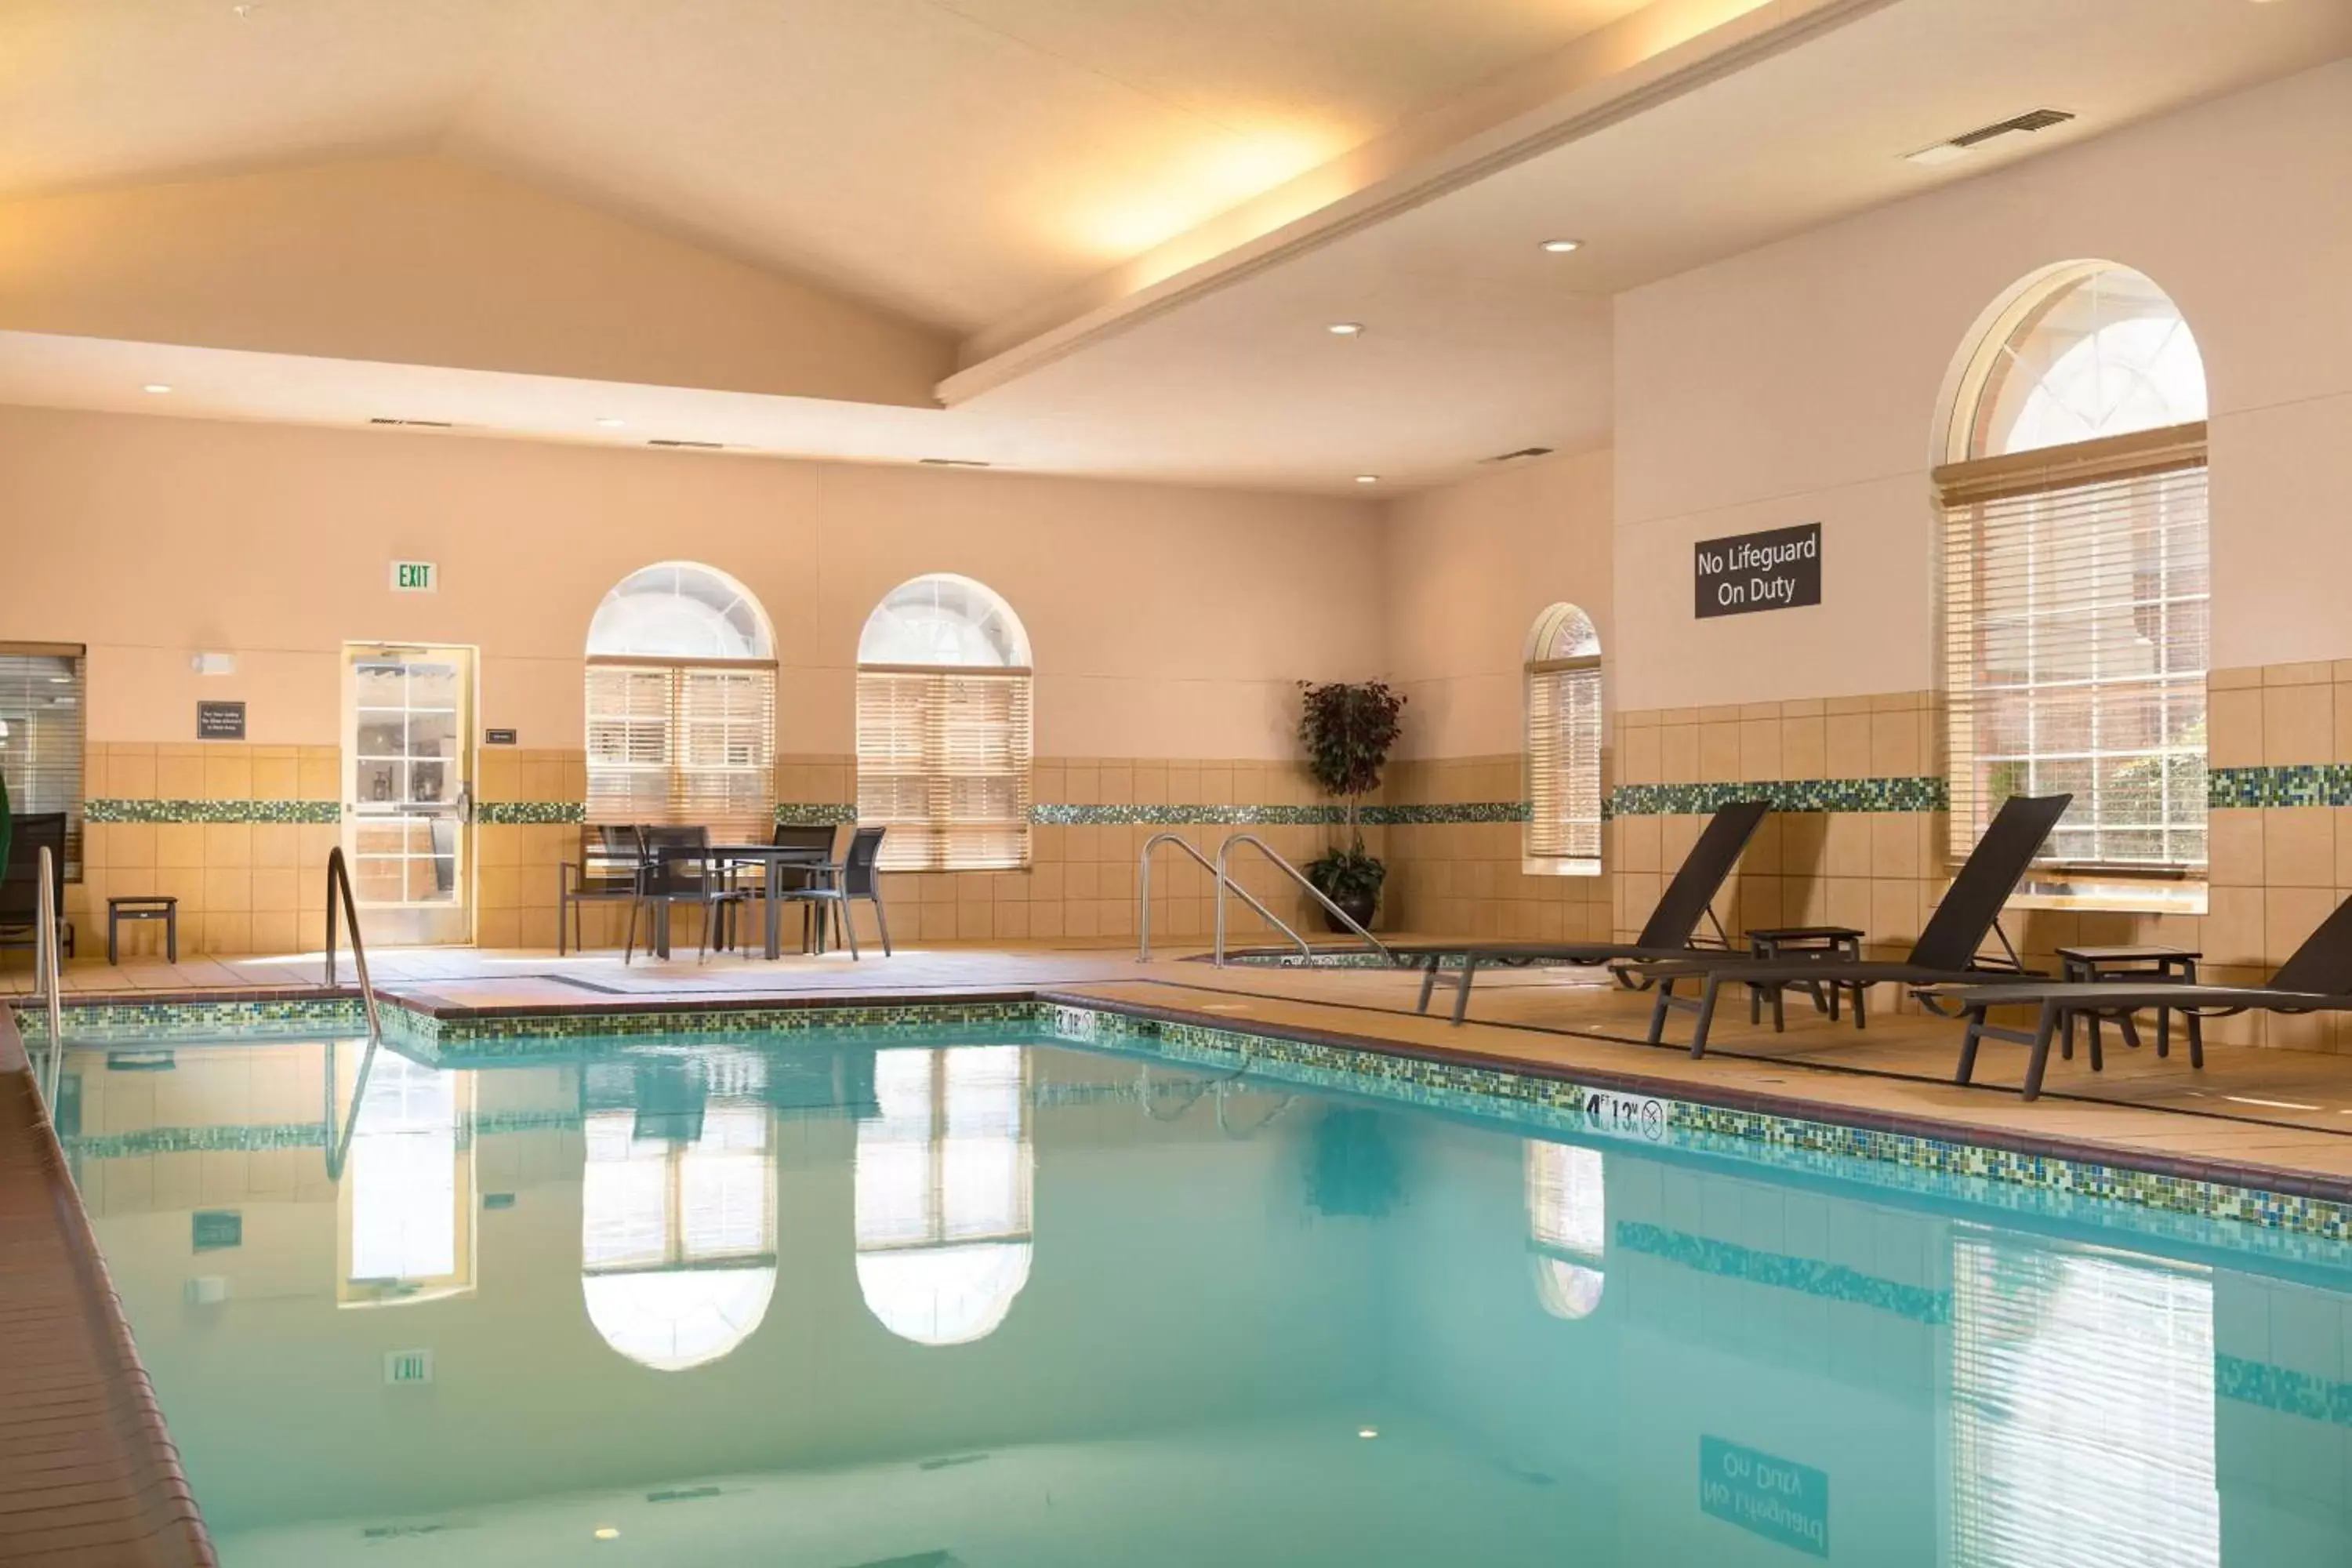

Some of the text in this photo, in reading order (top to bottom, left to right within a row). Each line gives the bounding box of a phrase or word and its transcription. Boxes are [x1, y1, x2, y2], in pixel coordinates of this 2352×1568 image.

[1699, 532, 1816, 576] No Lifeguard
[400, 564, 430, 587] EXIT
[1718, 576, 1796, 606] On Duty
